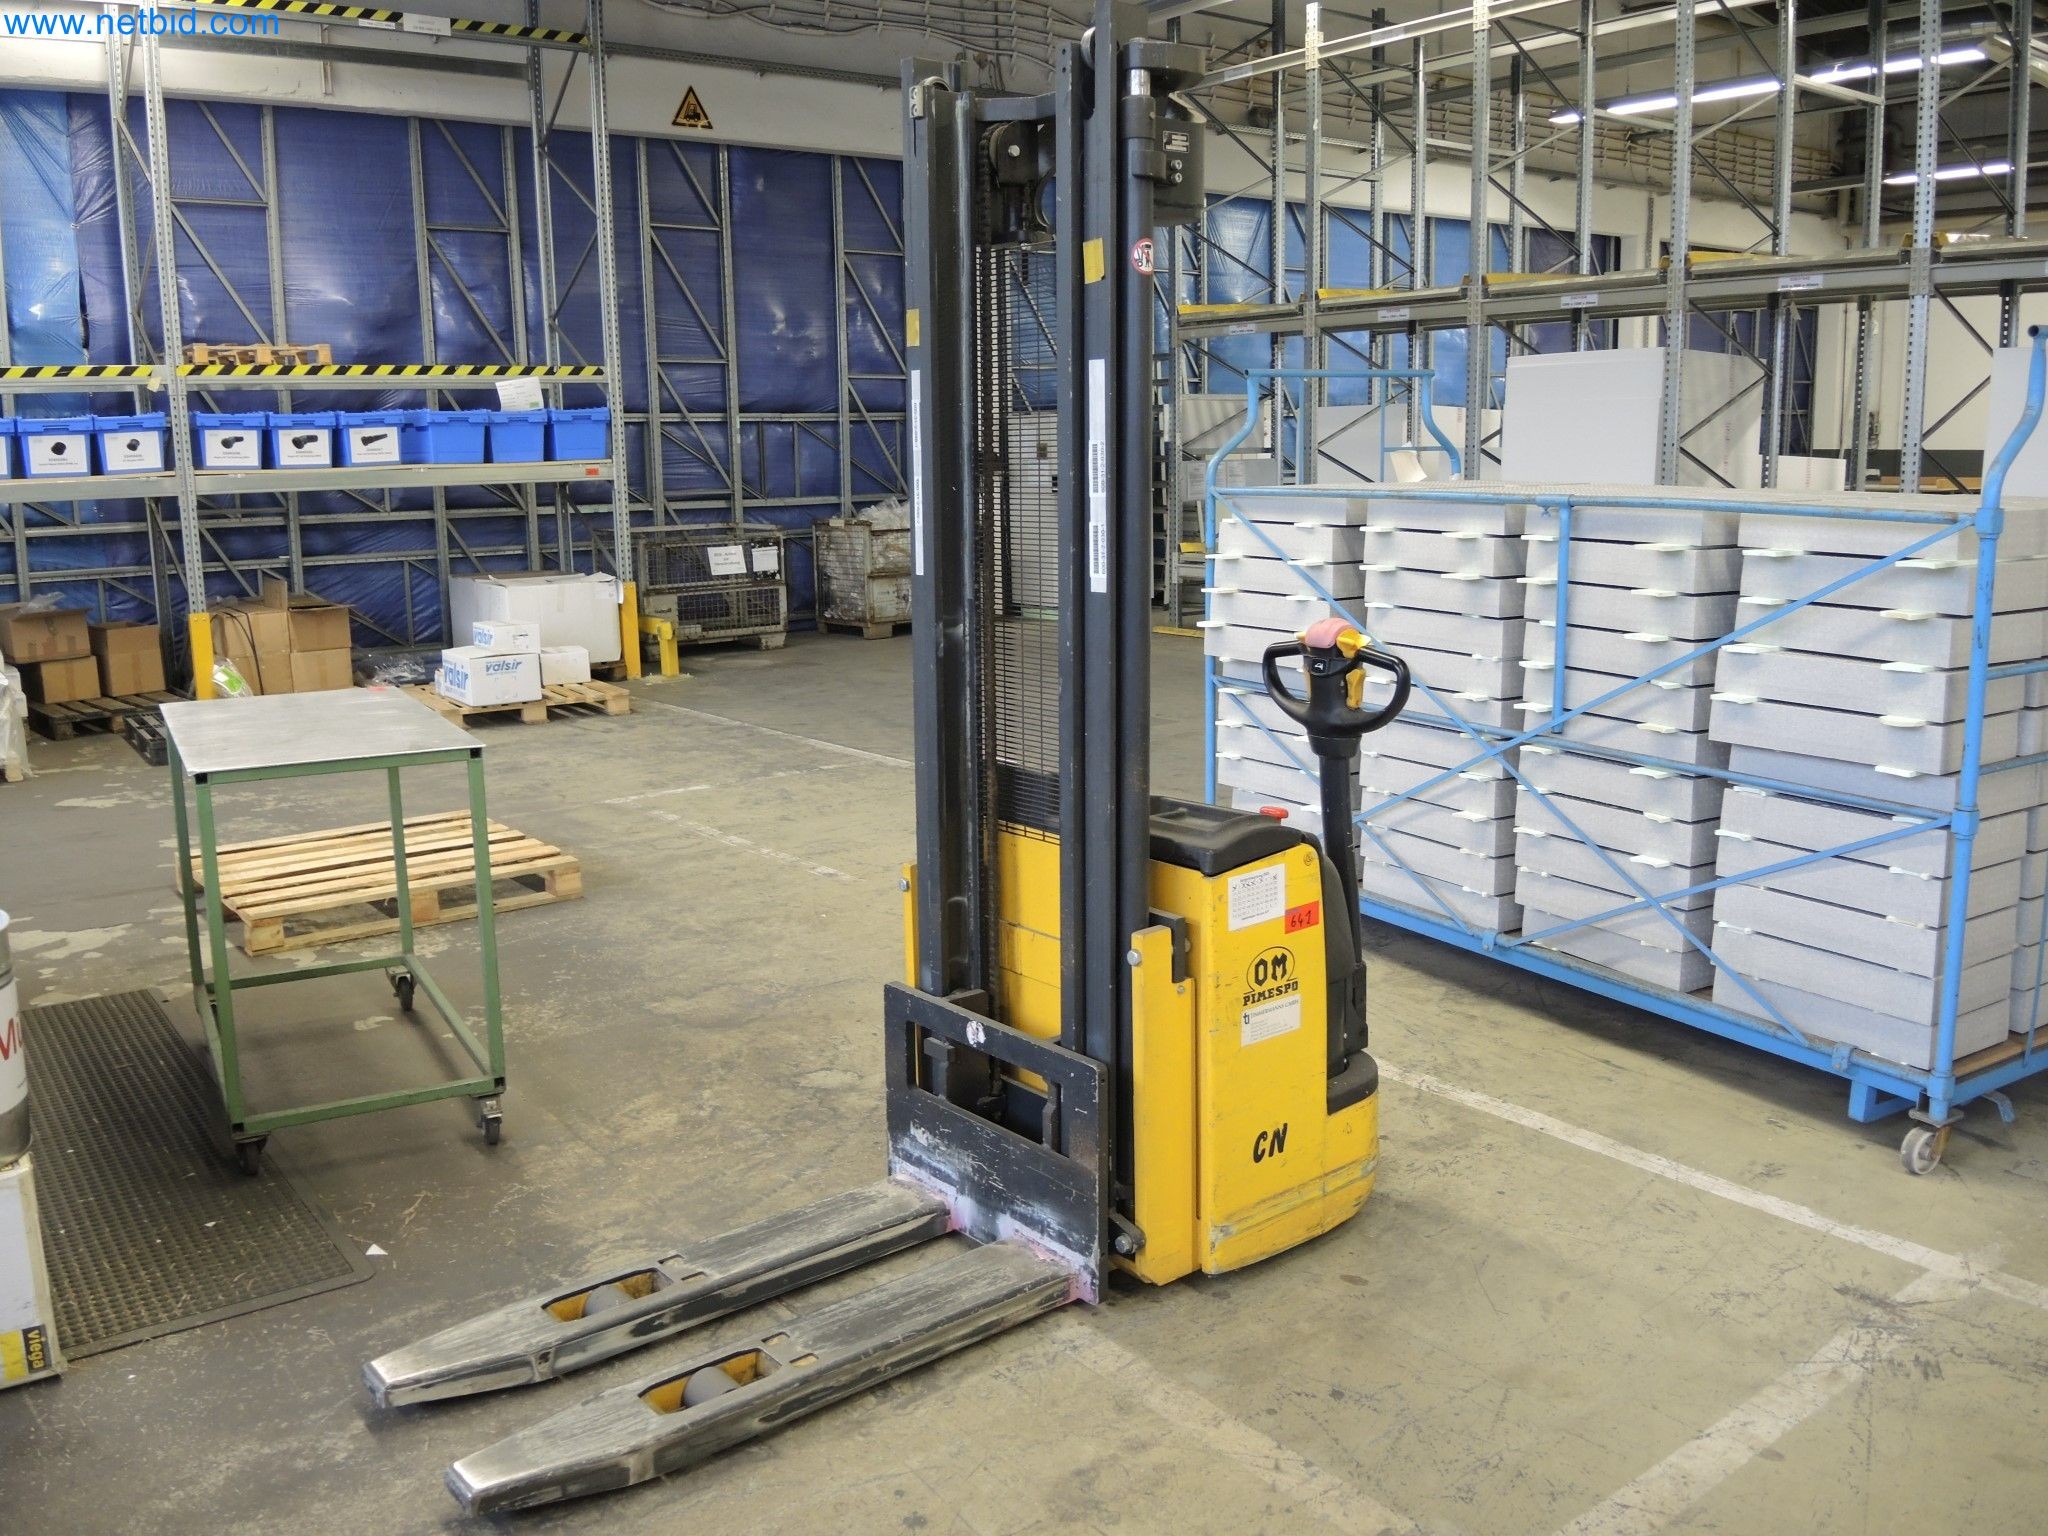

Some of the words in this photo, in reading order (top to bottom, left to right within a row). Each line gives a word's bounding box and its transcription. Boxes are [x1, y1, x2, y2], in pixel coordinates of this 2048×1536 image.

[473, 629, 493, 645] valsir
[443, 663, 468, 690] valsir
[486, 660, 522, 672] valsir
[1254, 953, 1288, 987] OM
[1243, 981, 1299, 1006] PIMESPO
[1253, 1122, 1288, 1164] CN
[27, 1330, 46, 1368] viega
